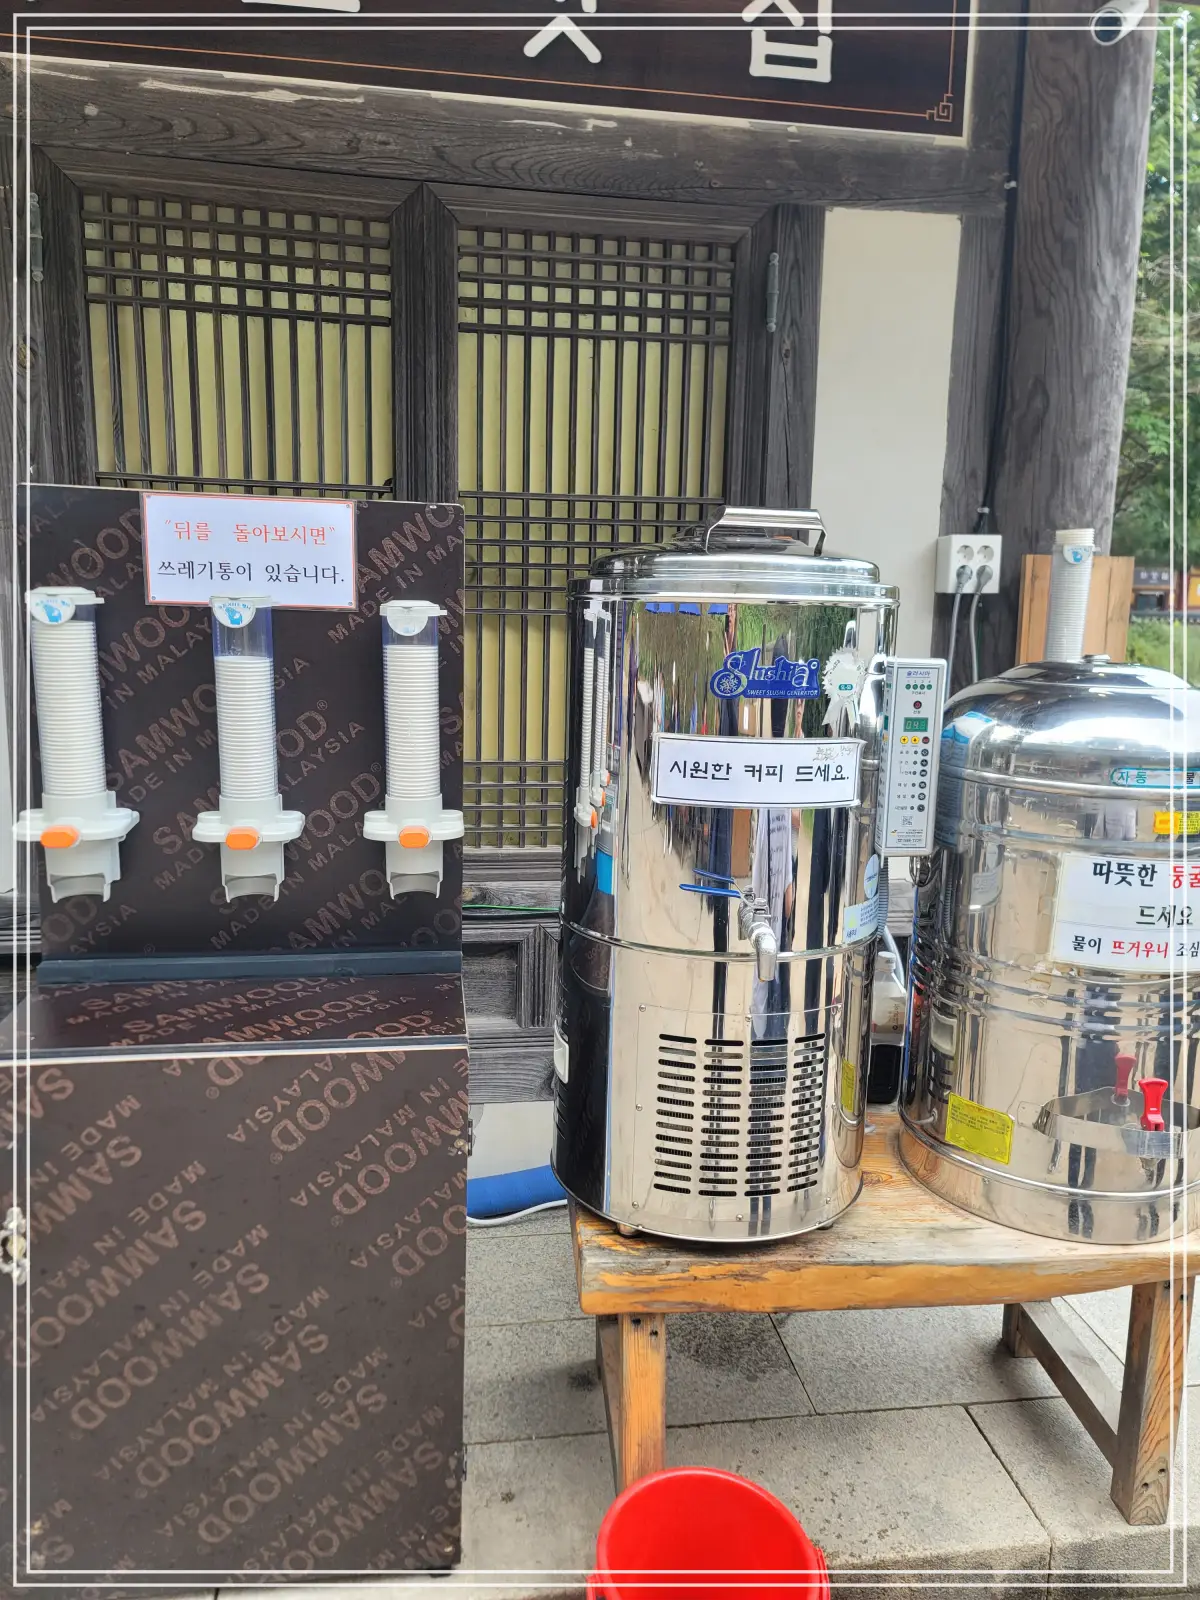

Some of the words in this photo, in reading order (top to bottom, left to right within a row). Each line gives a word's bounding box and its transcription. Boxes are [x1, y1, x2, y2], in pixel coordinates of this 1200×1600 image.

[157, 561, 253, 582] 쓰레기통이
[264, 564, 345, 585] 있습니다.
[396, 562, 424, 589] IN
[746, 688, 767, 696] SWEET
[786, 688, 818, 697] GENERATOR
[669, 760, 733, 781] 시원한
[744, 764, 784, 783] 커피
[794, 763, 850, 782] 드세요.
[1092, 860, 1158, 888] 따뜻한
[1072, 934, 1103, 955] 물이
[1111, 940, 1169, 959] 뜨거우니
[1135, 904, 1194, 929] 드세요
[61, 1094, 142, 1161] MADE
[290, 1104, 417, 1207] MALAYSIA
[127, 1160, 207, 1226] MADE
[192, 1223, 270, 1290] MADE
[30, 1317, 155, 1423] MALAYSIA
[70, 1262, 270, 1430] SAMWOOD
[135, 1324, 330, 1488] SAMWOOD
[197, 1383, 389, 1544] SAMWOOD
